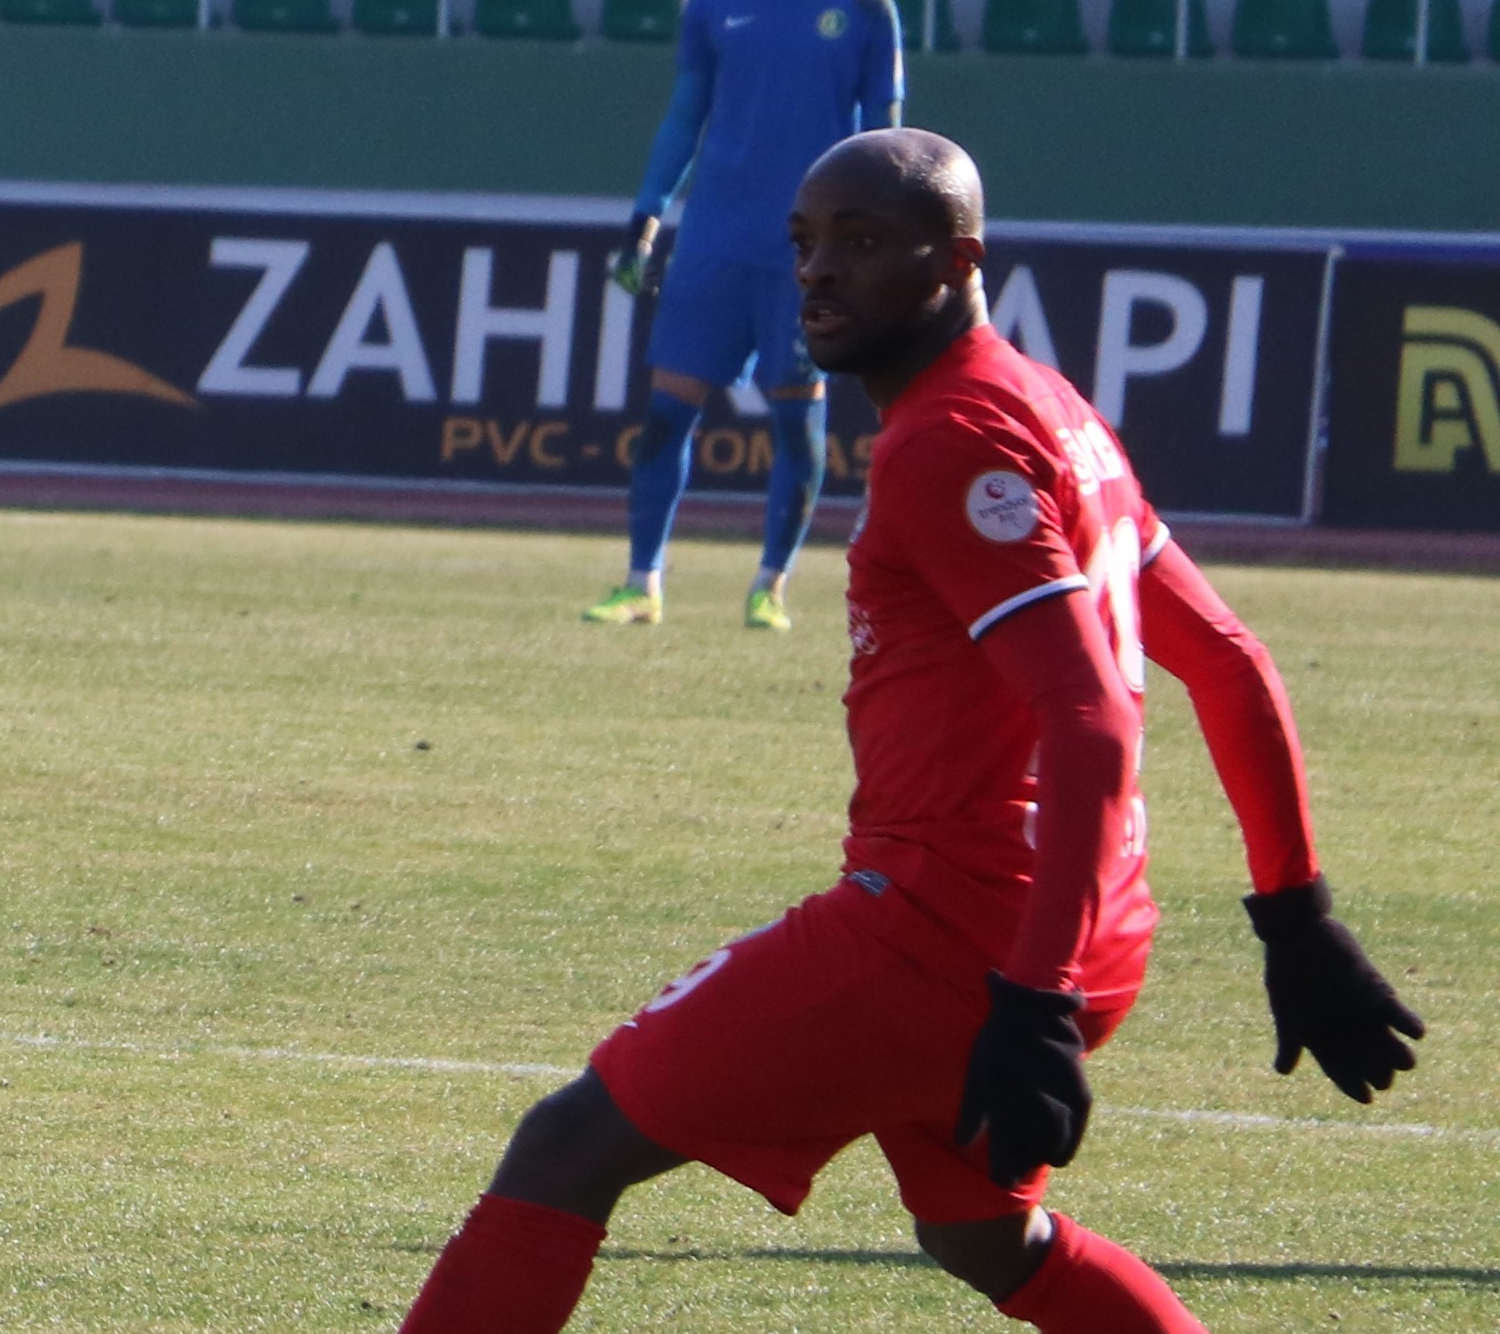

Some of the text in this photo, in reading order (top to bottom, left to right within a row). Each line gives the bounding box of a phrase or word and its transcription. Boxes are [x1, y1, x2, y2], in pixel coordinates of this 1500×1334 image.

[196, 235, 769, 416] ZAHI
[986, 263, 1265, 438] API
[440, 416, 570, 468] PVC
